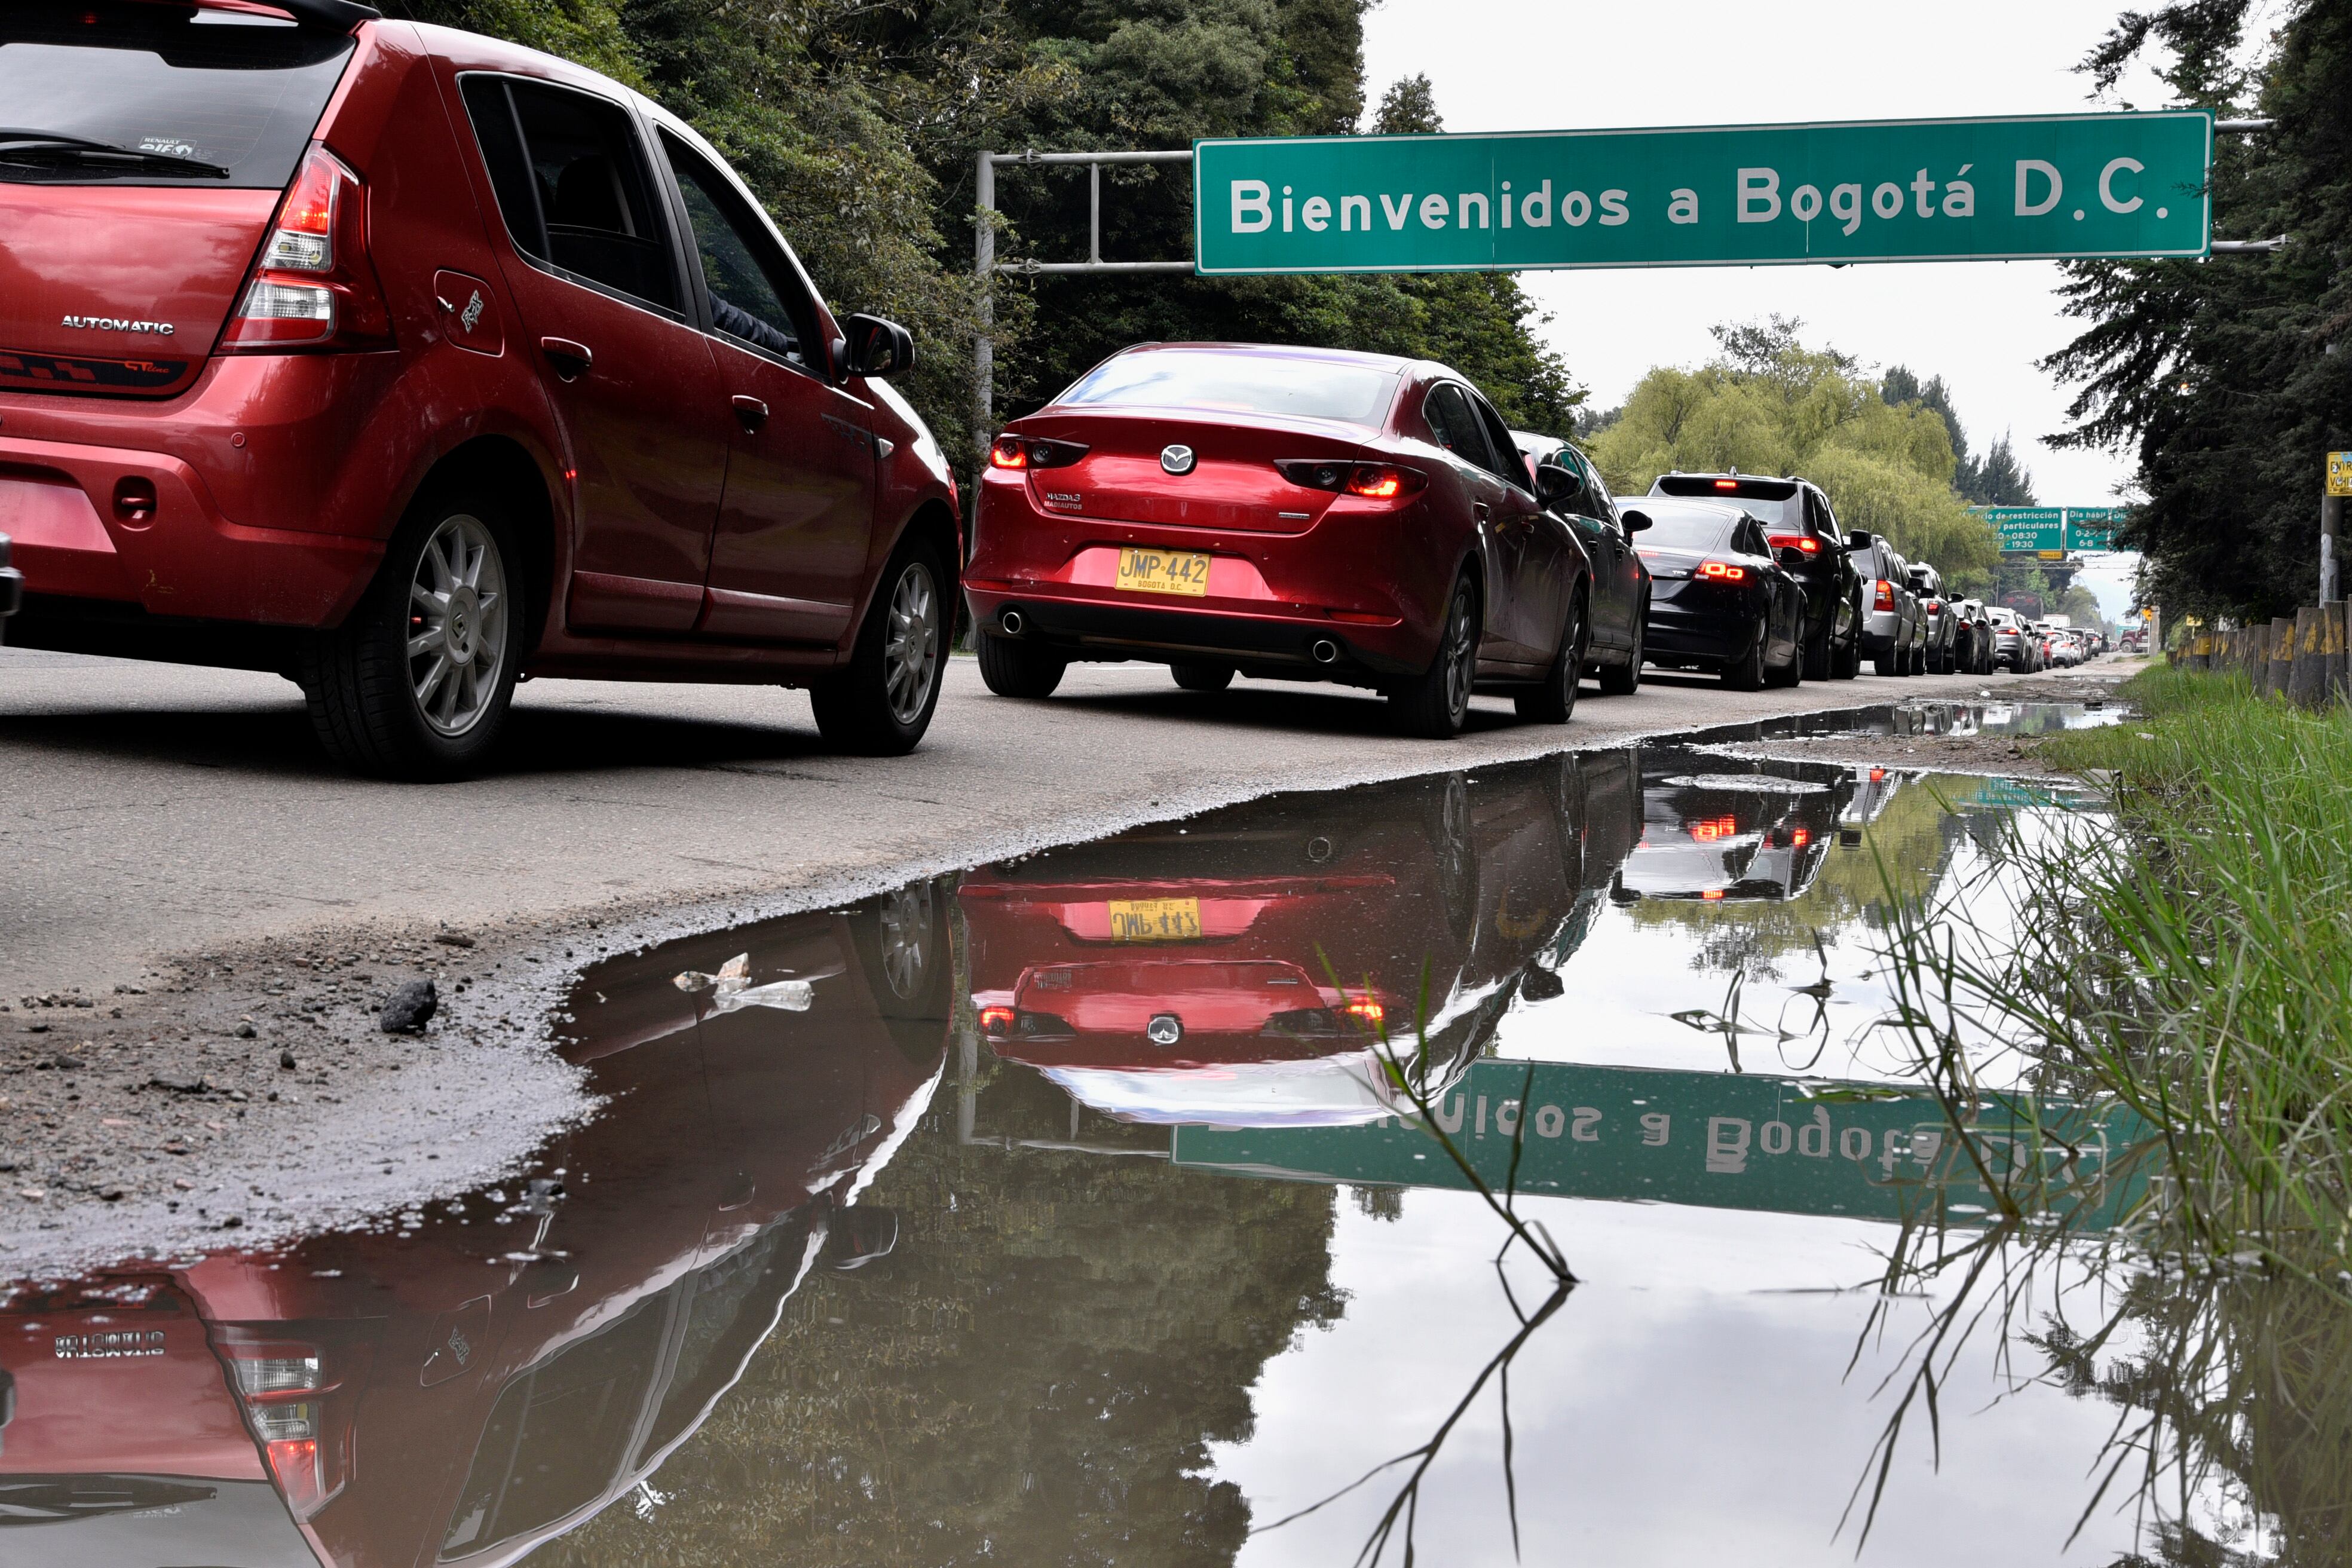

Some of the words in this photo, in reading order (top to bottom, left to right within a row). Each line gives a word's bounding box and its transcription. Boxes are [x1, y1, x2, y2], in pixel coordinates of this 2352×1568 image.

[1231, 179, 1630, 233] Bienvenidos
[1667, 188, 1698, 224] a
[1737, 163, 1974, 237] Bogotá
[2014, 157, 2168, 219] D.C.
[61, 315, 174, 336] AUTOMATIC
[1044, 500, 1082, 510] MADIAUTOS
[1138, 580, 1165, 589] BOGOTA
